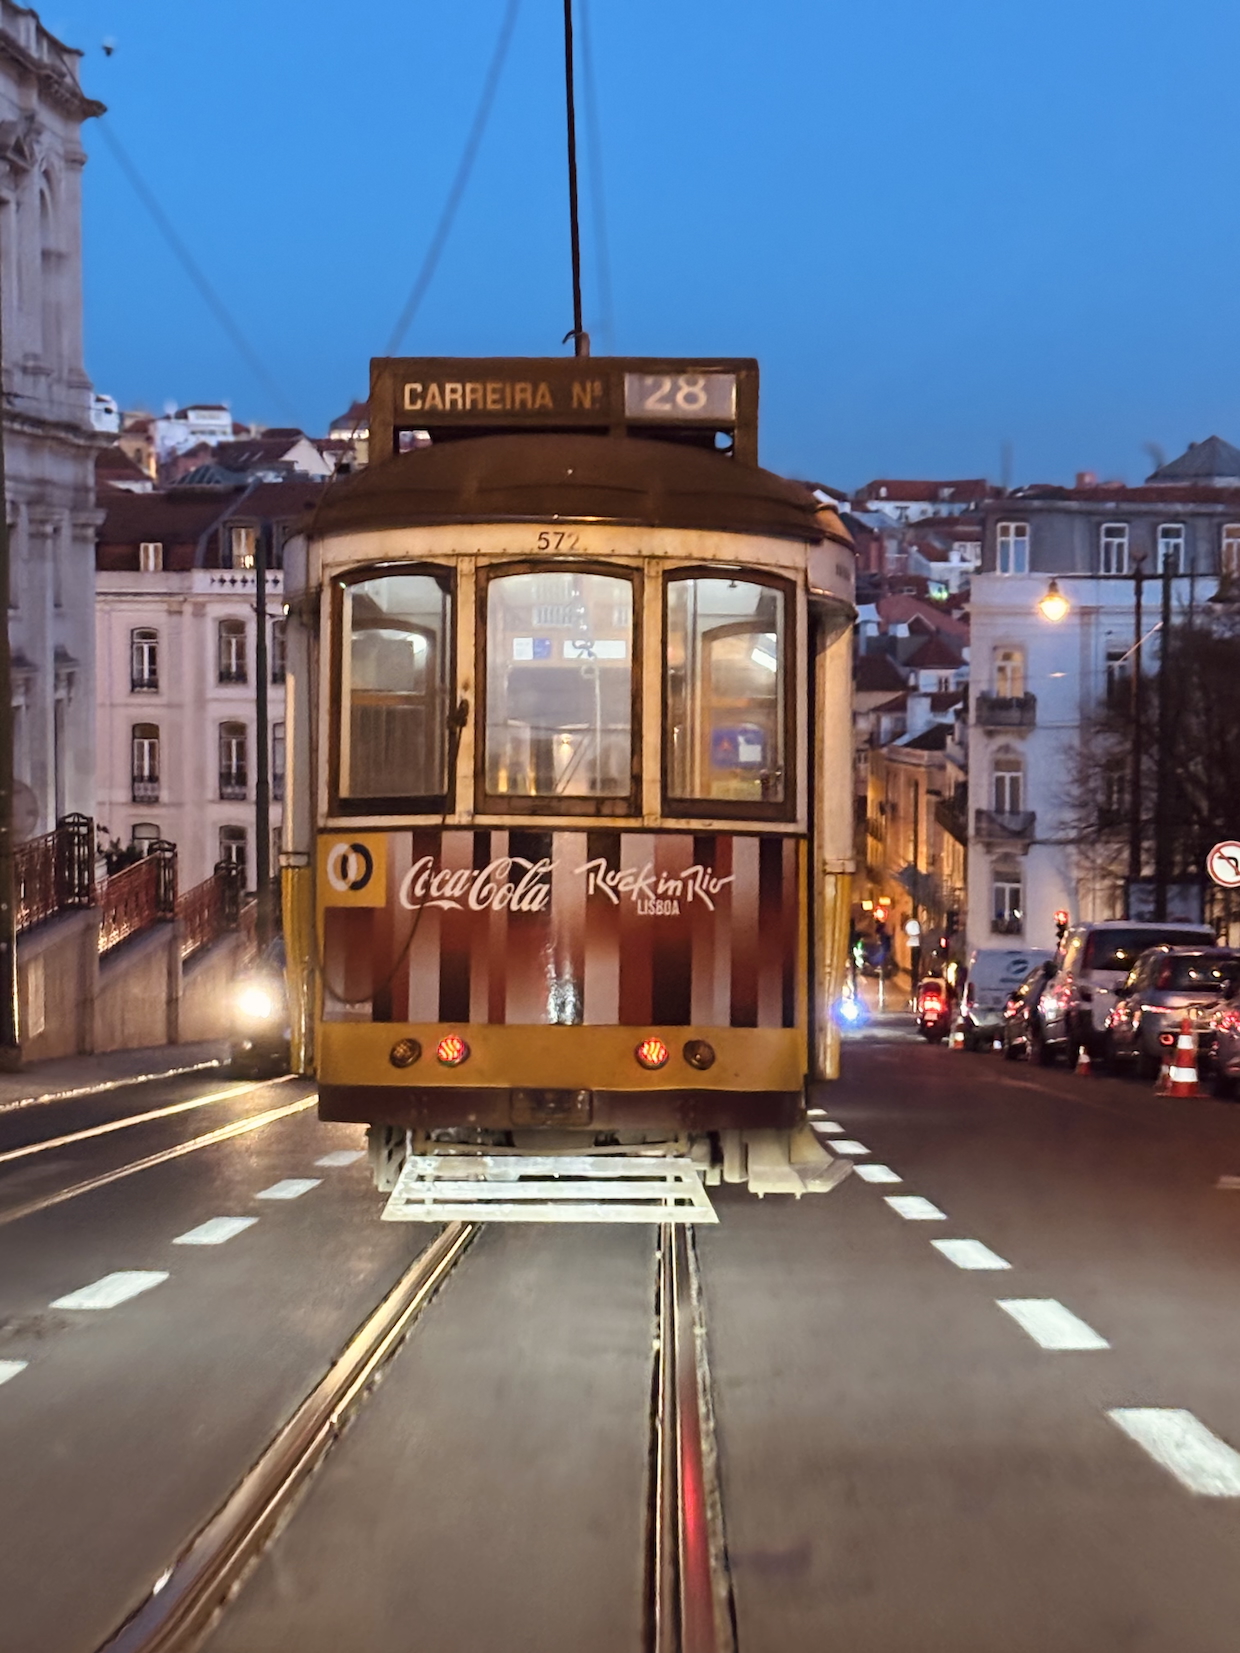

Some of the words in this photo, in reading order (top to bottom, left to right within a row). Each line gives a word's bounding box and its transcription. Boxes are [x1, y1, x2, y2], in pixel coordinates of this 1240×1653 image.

[403, 382, 554, 411] CARREIRA
[644, 373, 708, 411] 28
[537, 531, 580, 550] 572
[574, 857, 657, 905] Rock
[656, 871, 684, 896] in
[680, 864, 736, 911] Rio
[637, 898, 681, 915] LISBOA
